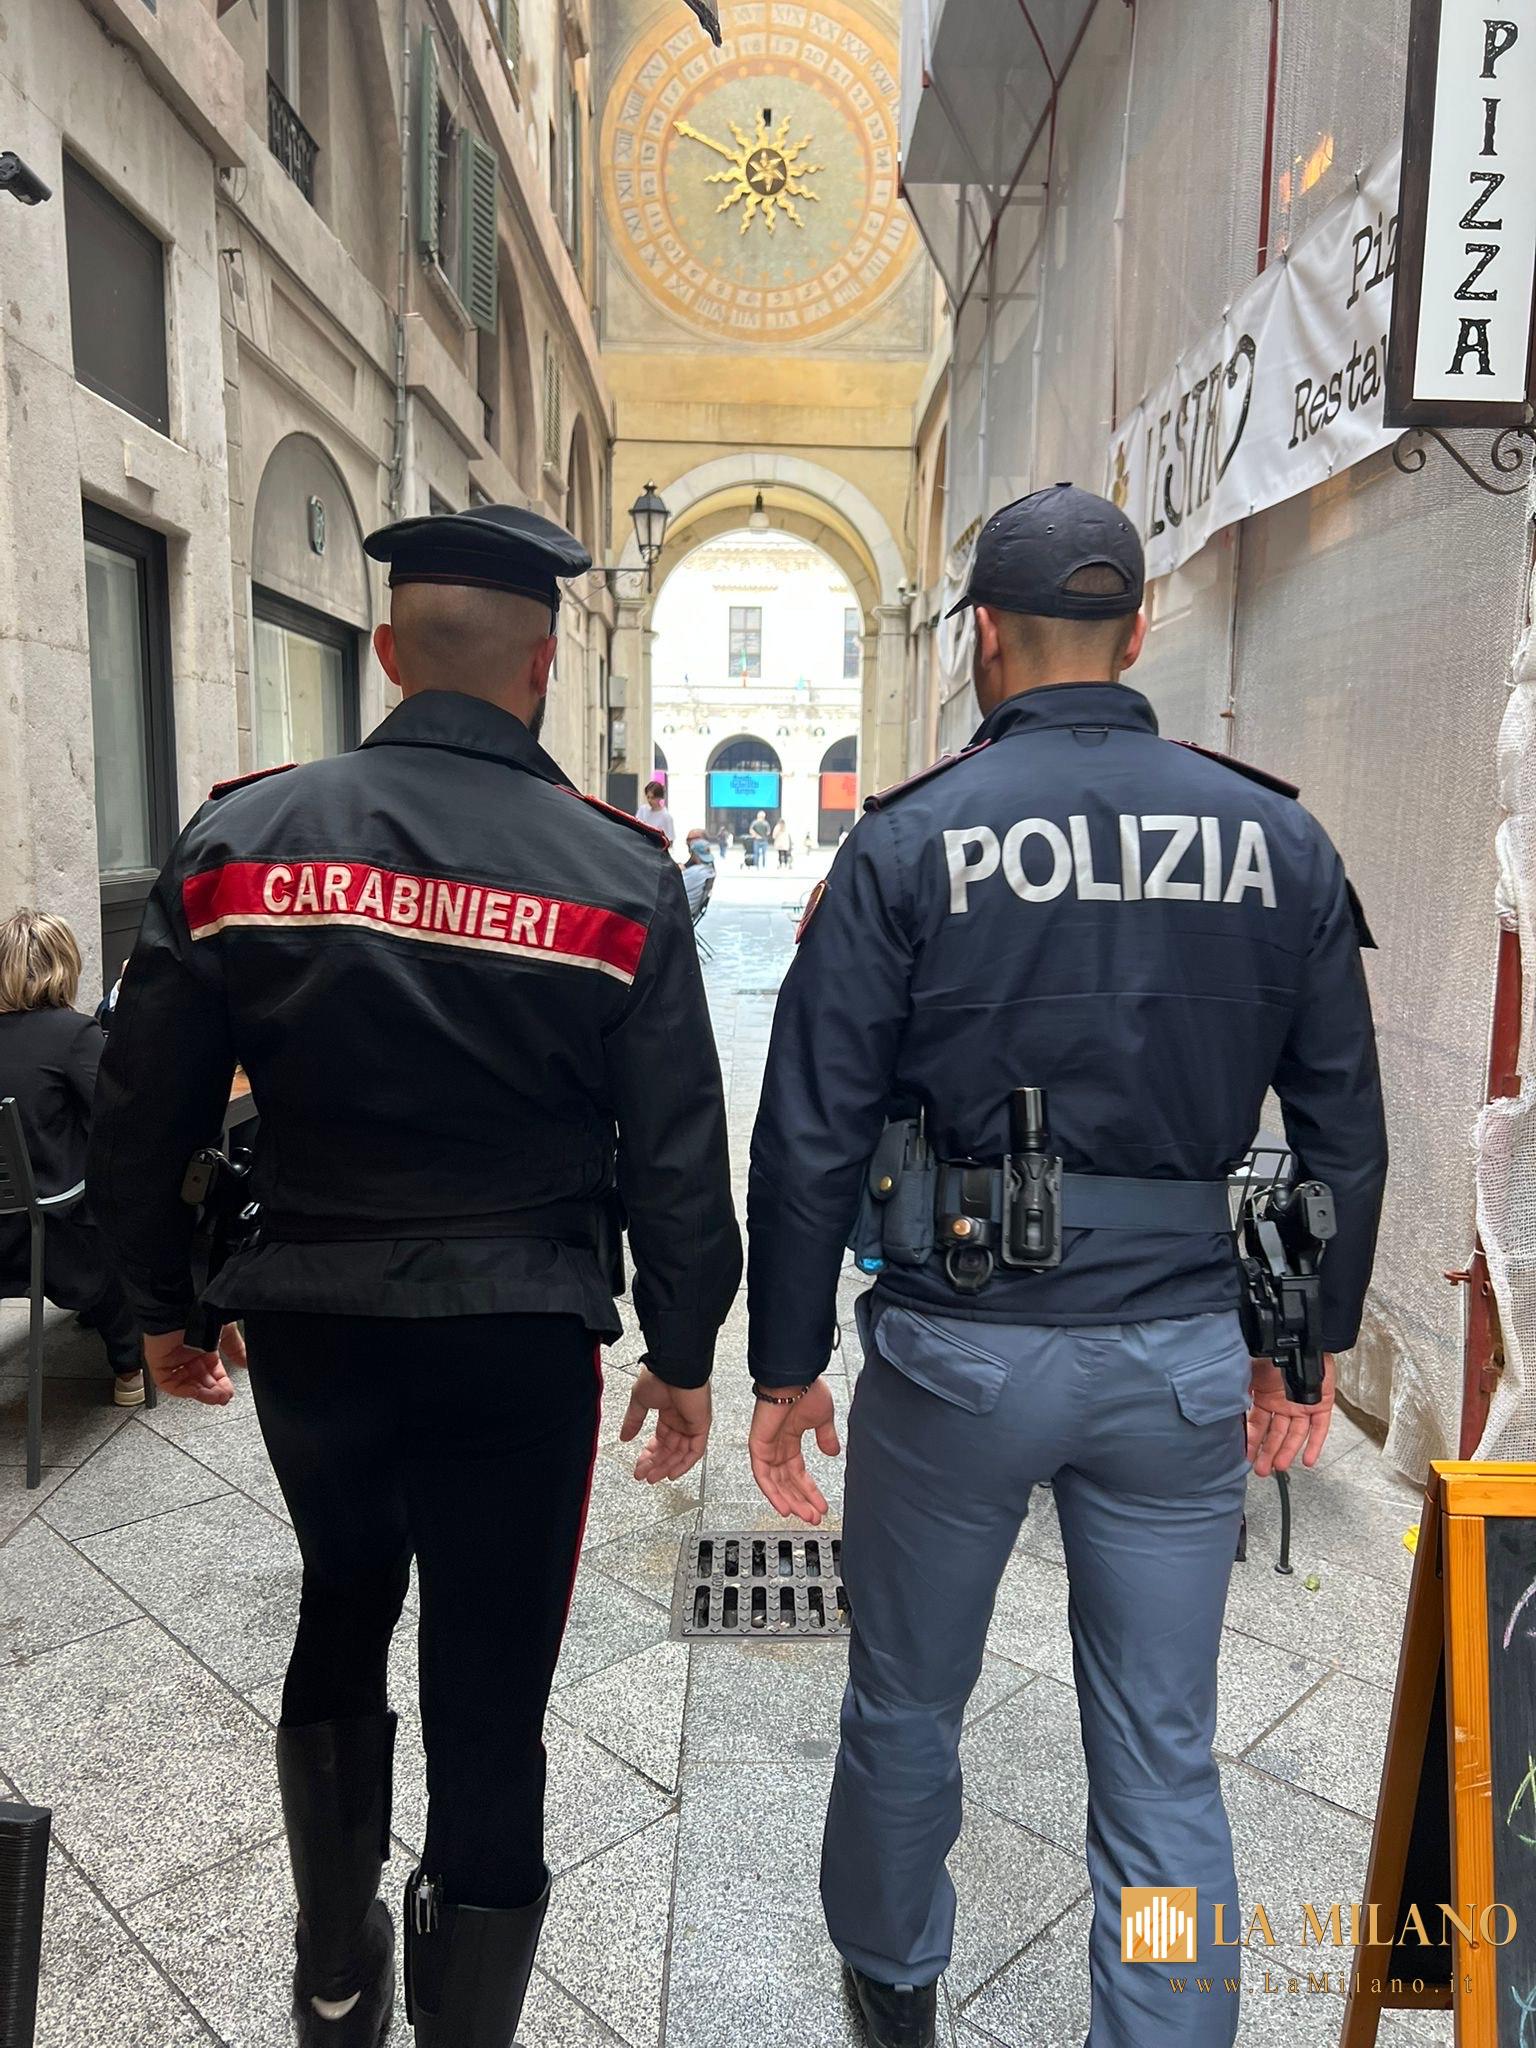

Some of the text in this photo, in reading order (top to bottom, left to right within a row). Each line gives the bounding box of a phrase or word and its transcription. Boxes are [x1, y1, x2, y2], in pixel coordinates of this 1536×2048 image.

[804, 46, 825, 65] 20
[850, 86, 871, 109] 22
[642, 177, 656, 196] 12
[1445, 19, 1519, 376] PIZZA
[662, 237, 682, 260] 10
[1288, 334, 1388, 450] Resta
[942, 814, 1277, 914] POLIZIA
[262, 864, 561, 948] CARABINIERI
